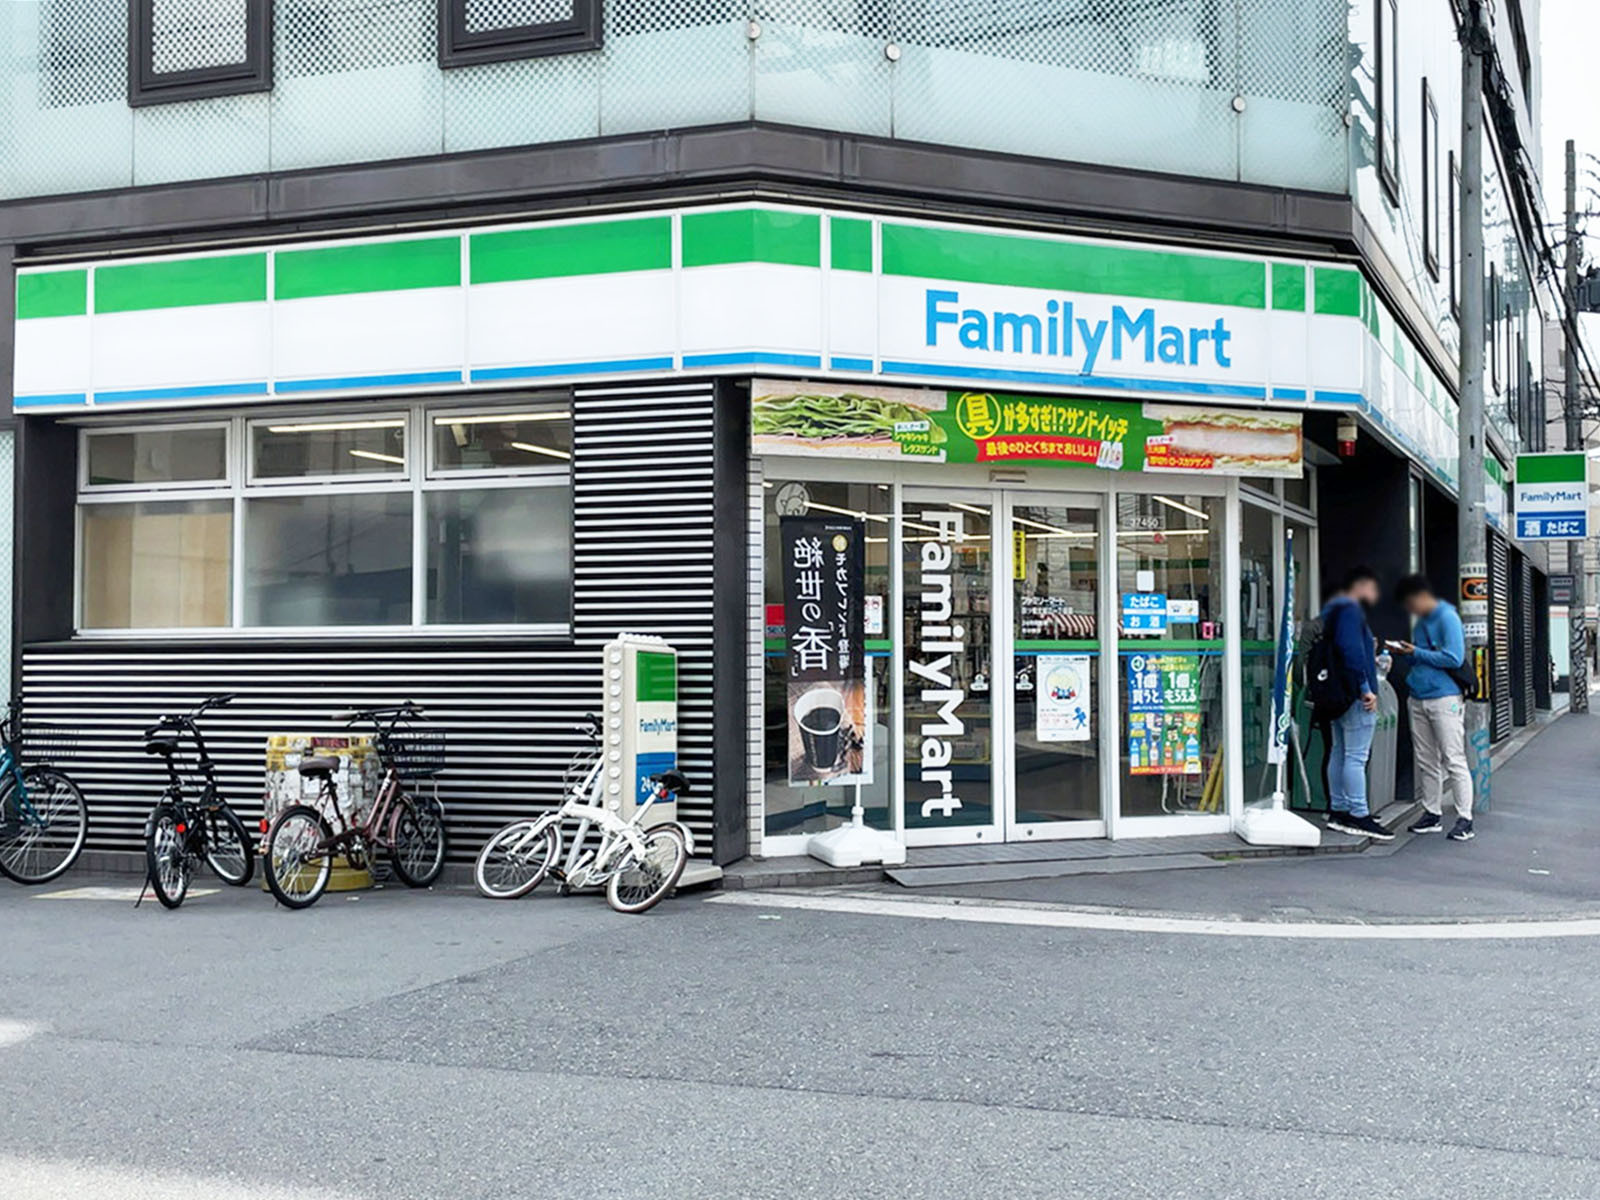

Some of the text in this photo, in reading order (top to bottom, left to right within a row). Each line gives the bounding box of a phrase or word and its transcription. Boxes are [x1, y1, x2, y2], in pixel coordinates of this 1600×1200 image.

[925, 288, 1231, 376] FamilyMart
[985, 441, 1098, 458] 最後のひとくちまでおいしい
[1520, 491, 1582, 503] FamilyMart
[1546, 521, 1580, 535] たばこ
[1129, 596, 1160, 609] たばこ
[908, 510, 965, 818] FamilyMart
[639, 719, 676, 736] FamilyMart
